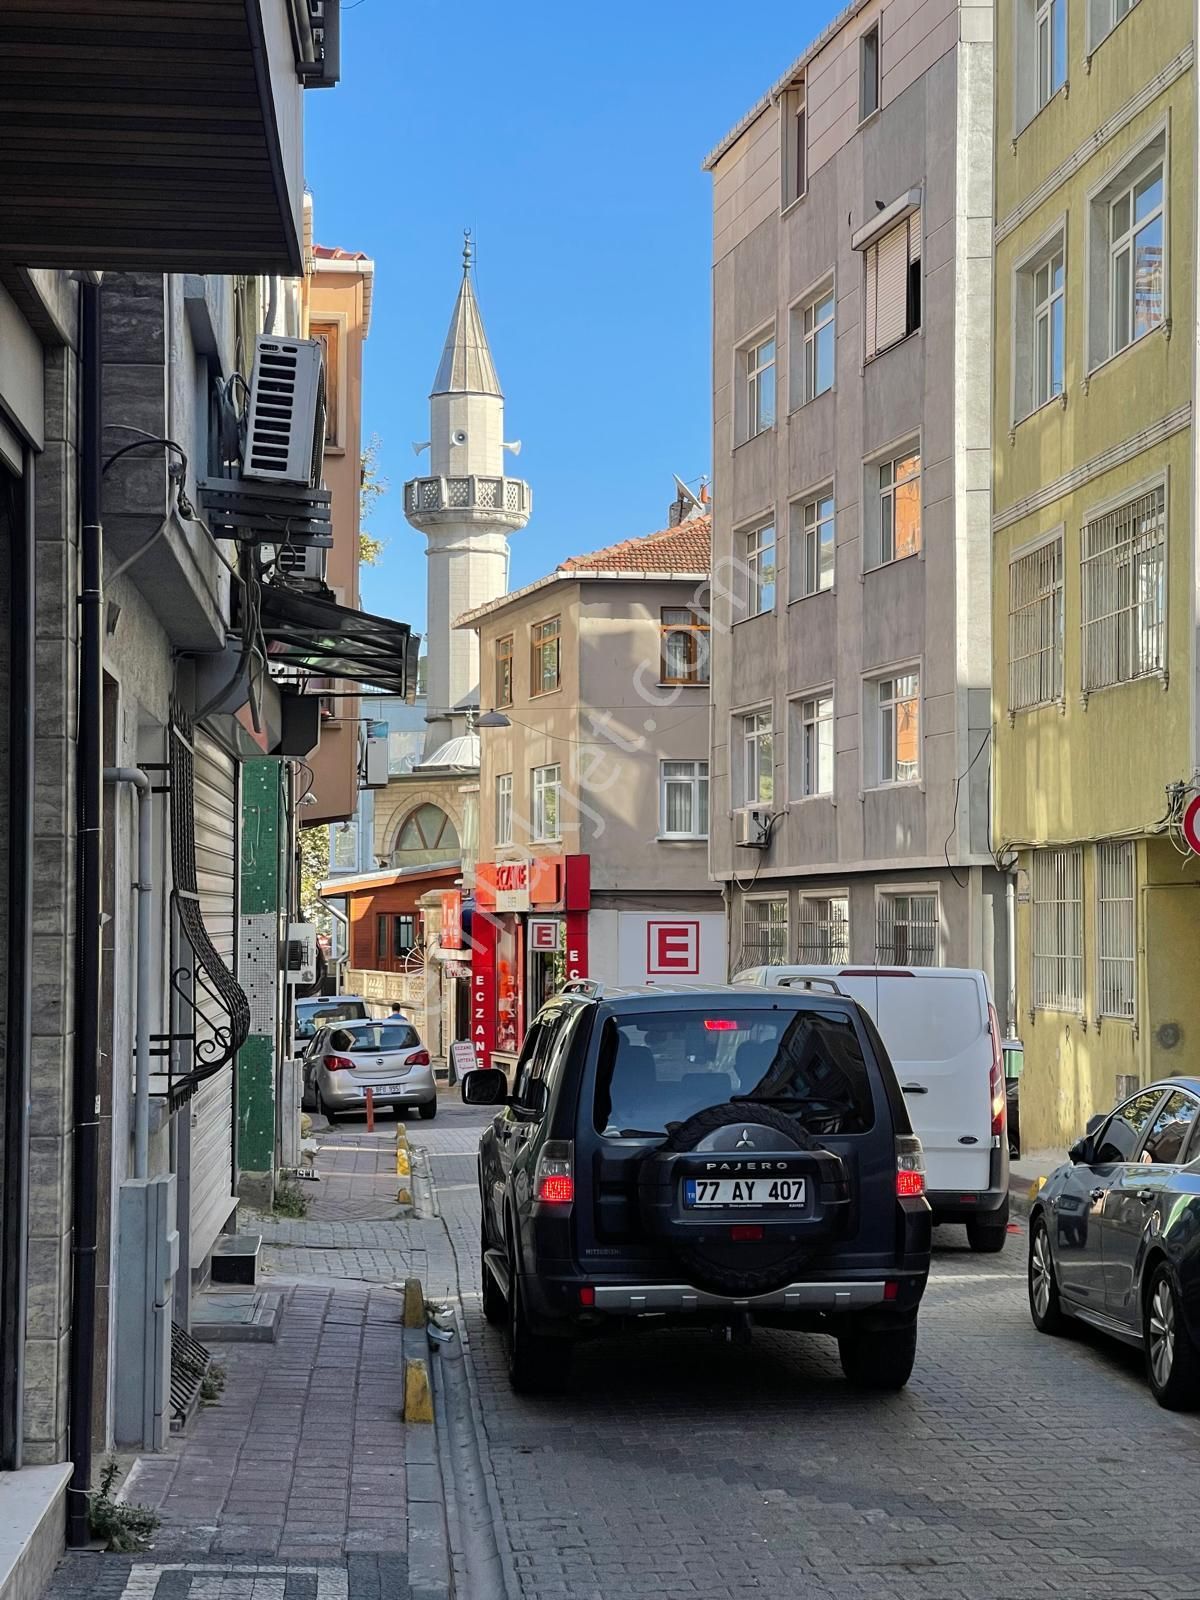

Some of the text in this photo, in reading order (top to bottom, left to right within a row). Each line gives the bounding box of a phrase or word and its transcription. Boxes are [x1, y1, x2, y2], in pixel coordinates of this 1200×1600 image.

[536, 926, 552, 945] E
[658, 928, 689, 967] E
[475, 975, 485, 1067] ECZANE
[706, 1162, 788, 1171] PAJERO
[697, 1181, 721, 1201] 77
[732, 1181, 755, 1201] AY
[768, 1181, 803, 1201] 407
